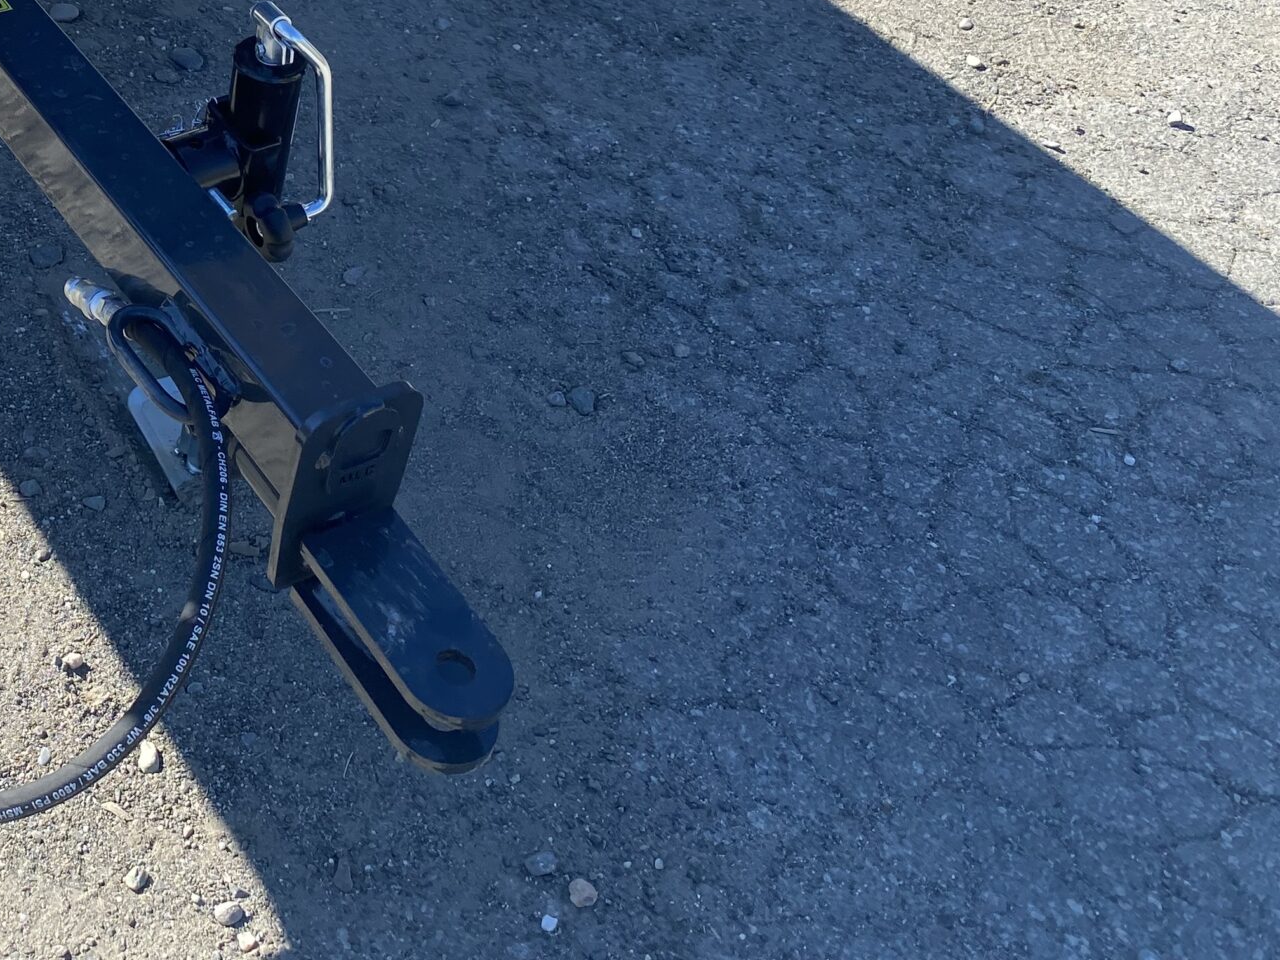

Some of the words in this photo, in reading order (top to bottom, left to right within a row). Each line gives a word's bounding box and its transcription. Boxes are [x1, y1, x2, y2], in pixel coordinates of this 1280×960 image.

[197, 384, 220, 428] METALFAB
[217, 452, 228, 484] CH206
[219, 492, 229, 512] DIN
[218, 514, 228, 531] EN
[215, 533, 226, 553] 853
[210, 555, 222, 580] 2SN
[204, 581, 217, 600] DN
[199, 602, 210, 617] 10
[186, 624, 203, 651] SAE
[175, 652, 190, 673] 100
[157, 673, 179, 705] R2AT
[126, 726, 143, 745] WP
[106, 743, 126, 762] 330
[83, 759, 108, 781] BAR
[52, 782, 77, 801] 4800
[31, 795, 51, 810] PSI
